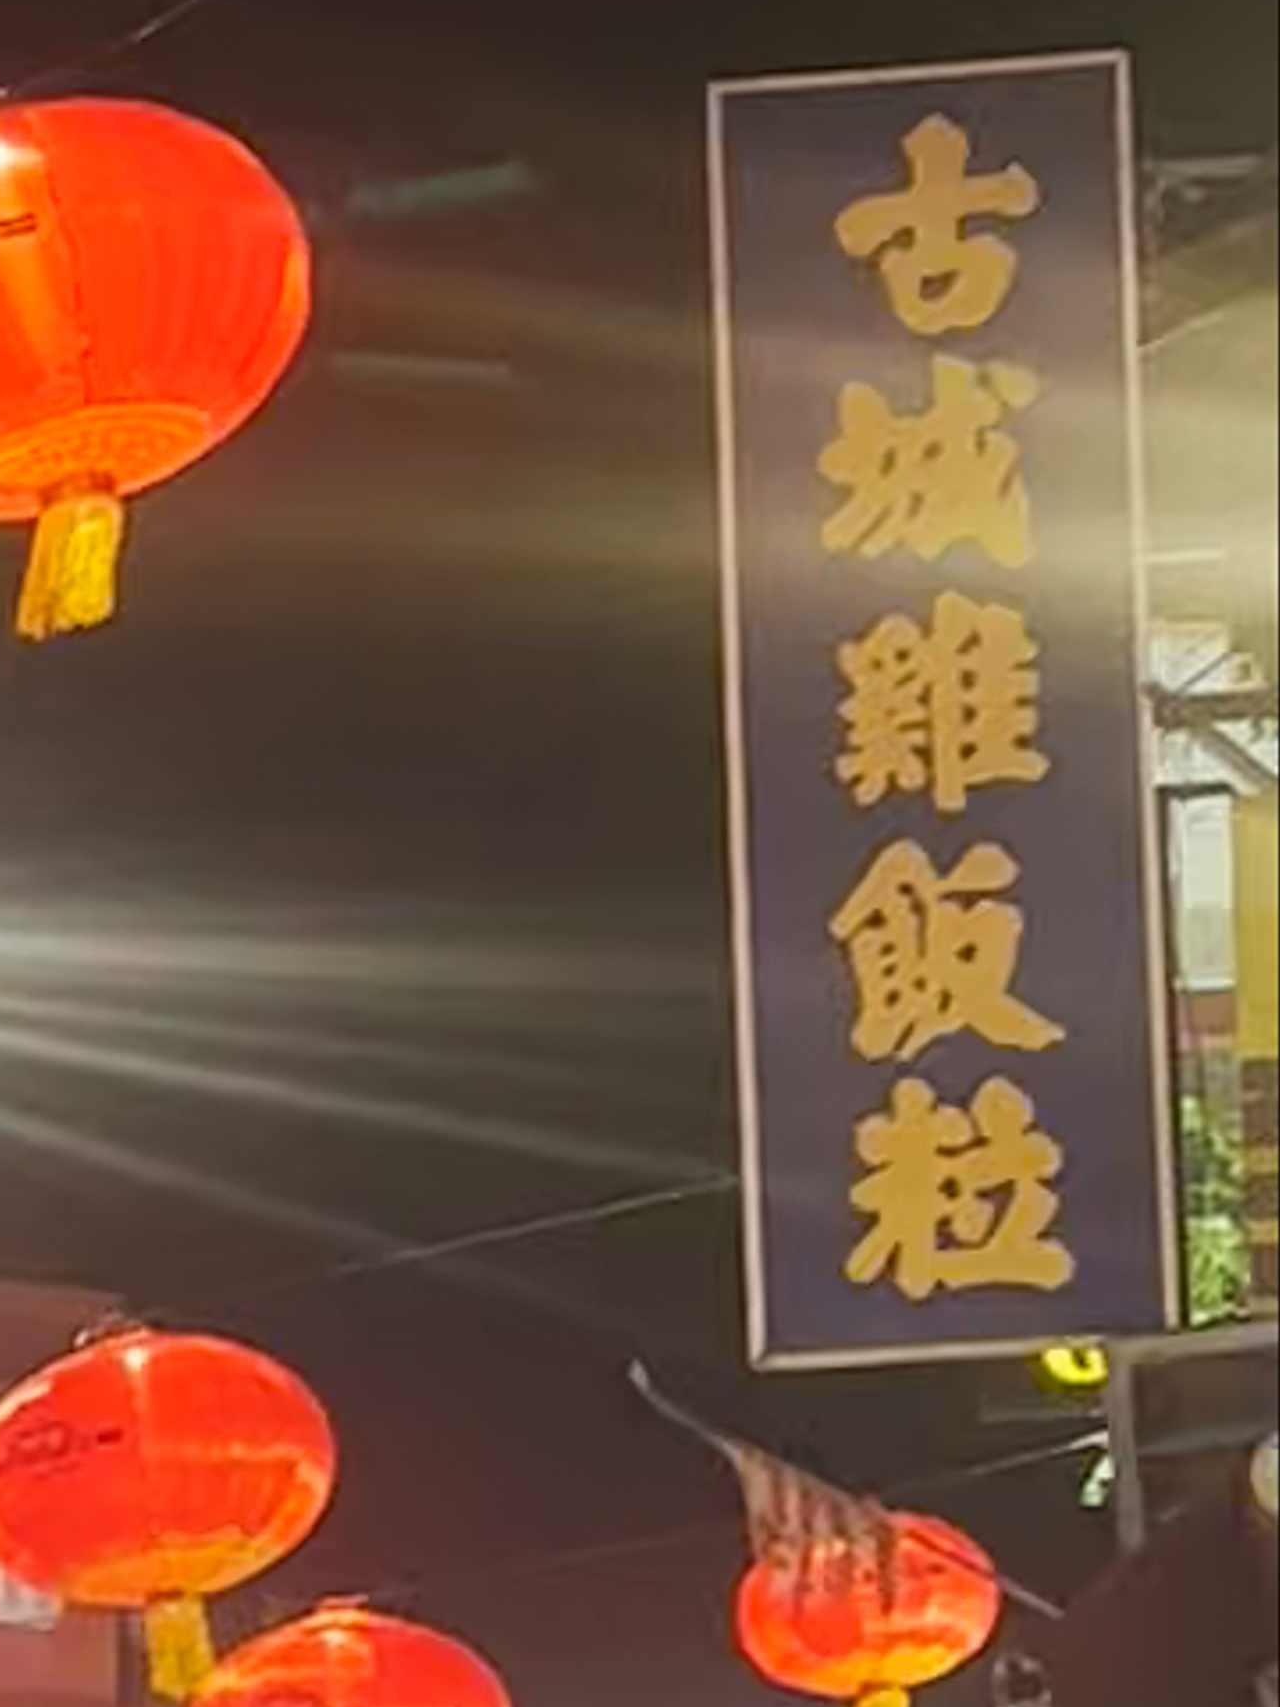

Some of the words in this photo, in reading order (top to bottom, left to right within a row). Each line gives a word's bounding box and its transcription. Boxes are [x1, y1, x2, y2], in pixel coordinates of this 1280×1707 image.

[820, 113, 1076, 1301] 古城雞飯粒
